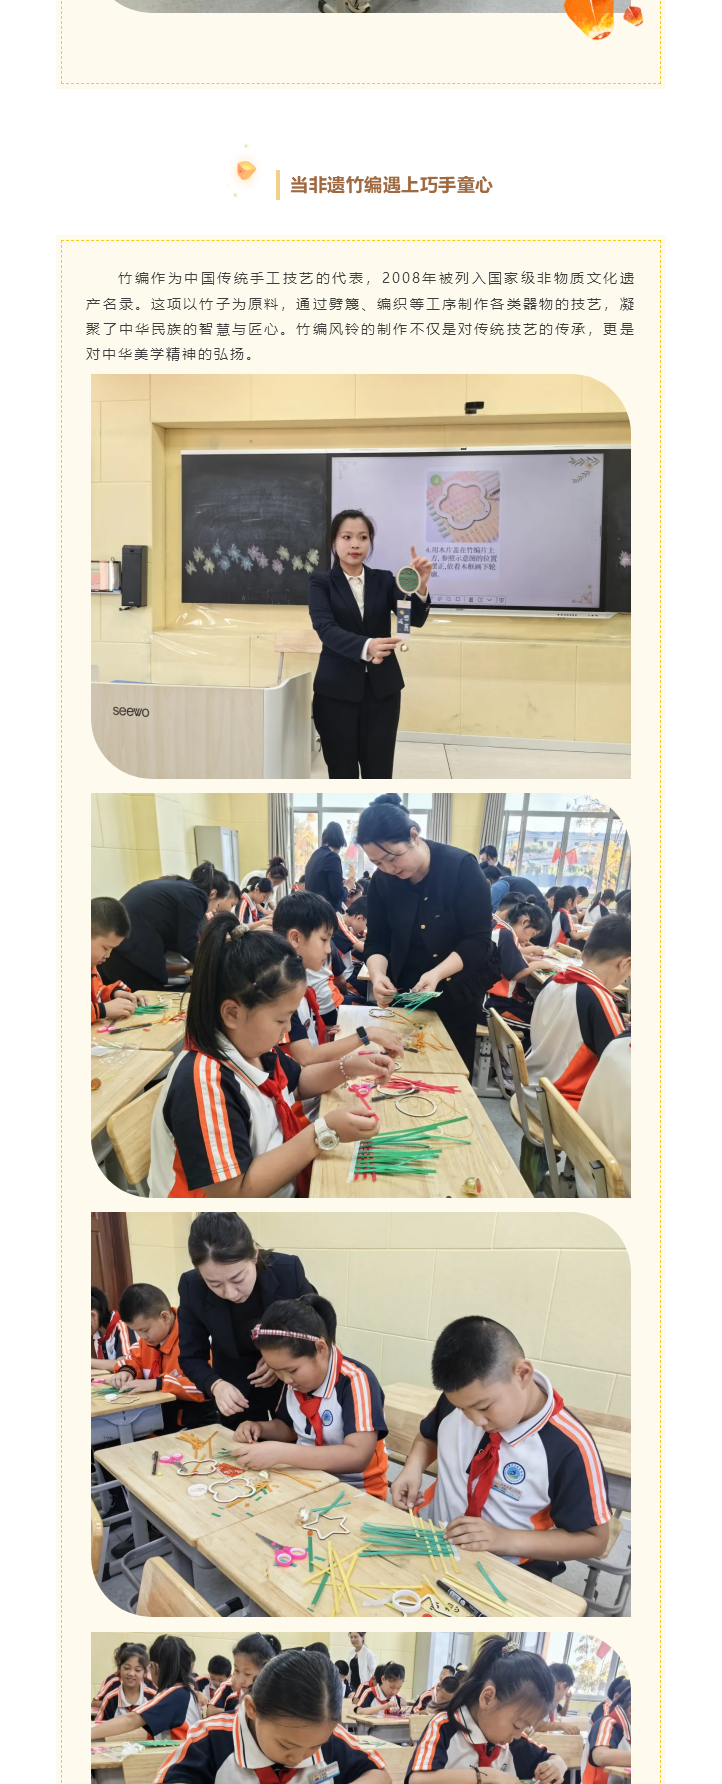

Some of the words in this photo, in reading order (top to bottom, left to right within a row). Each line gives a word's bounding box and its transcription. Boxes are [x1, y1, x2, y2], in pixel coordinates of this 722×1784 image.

[290, 176, 494, 195] 当非遗竹编遇上巧手童心
[117, 270, 635, 286] 竹编作为中国传统手工技艺的代表，2008年被列入国家级非物质文化遗
[86, 322, 635, 337] 聚了中华民族的智慧与匠心。竹编风铃的制作不仅是对传统技艺的传承，更是
[86, 346, 252, 362] 对中华美学精神的弘扬。
[113, 706, 150, 718] seewo
